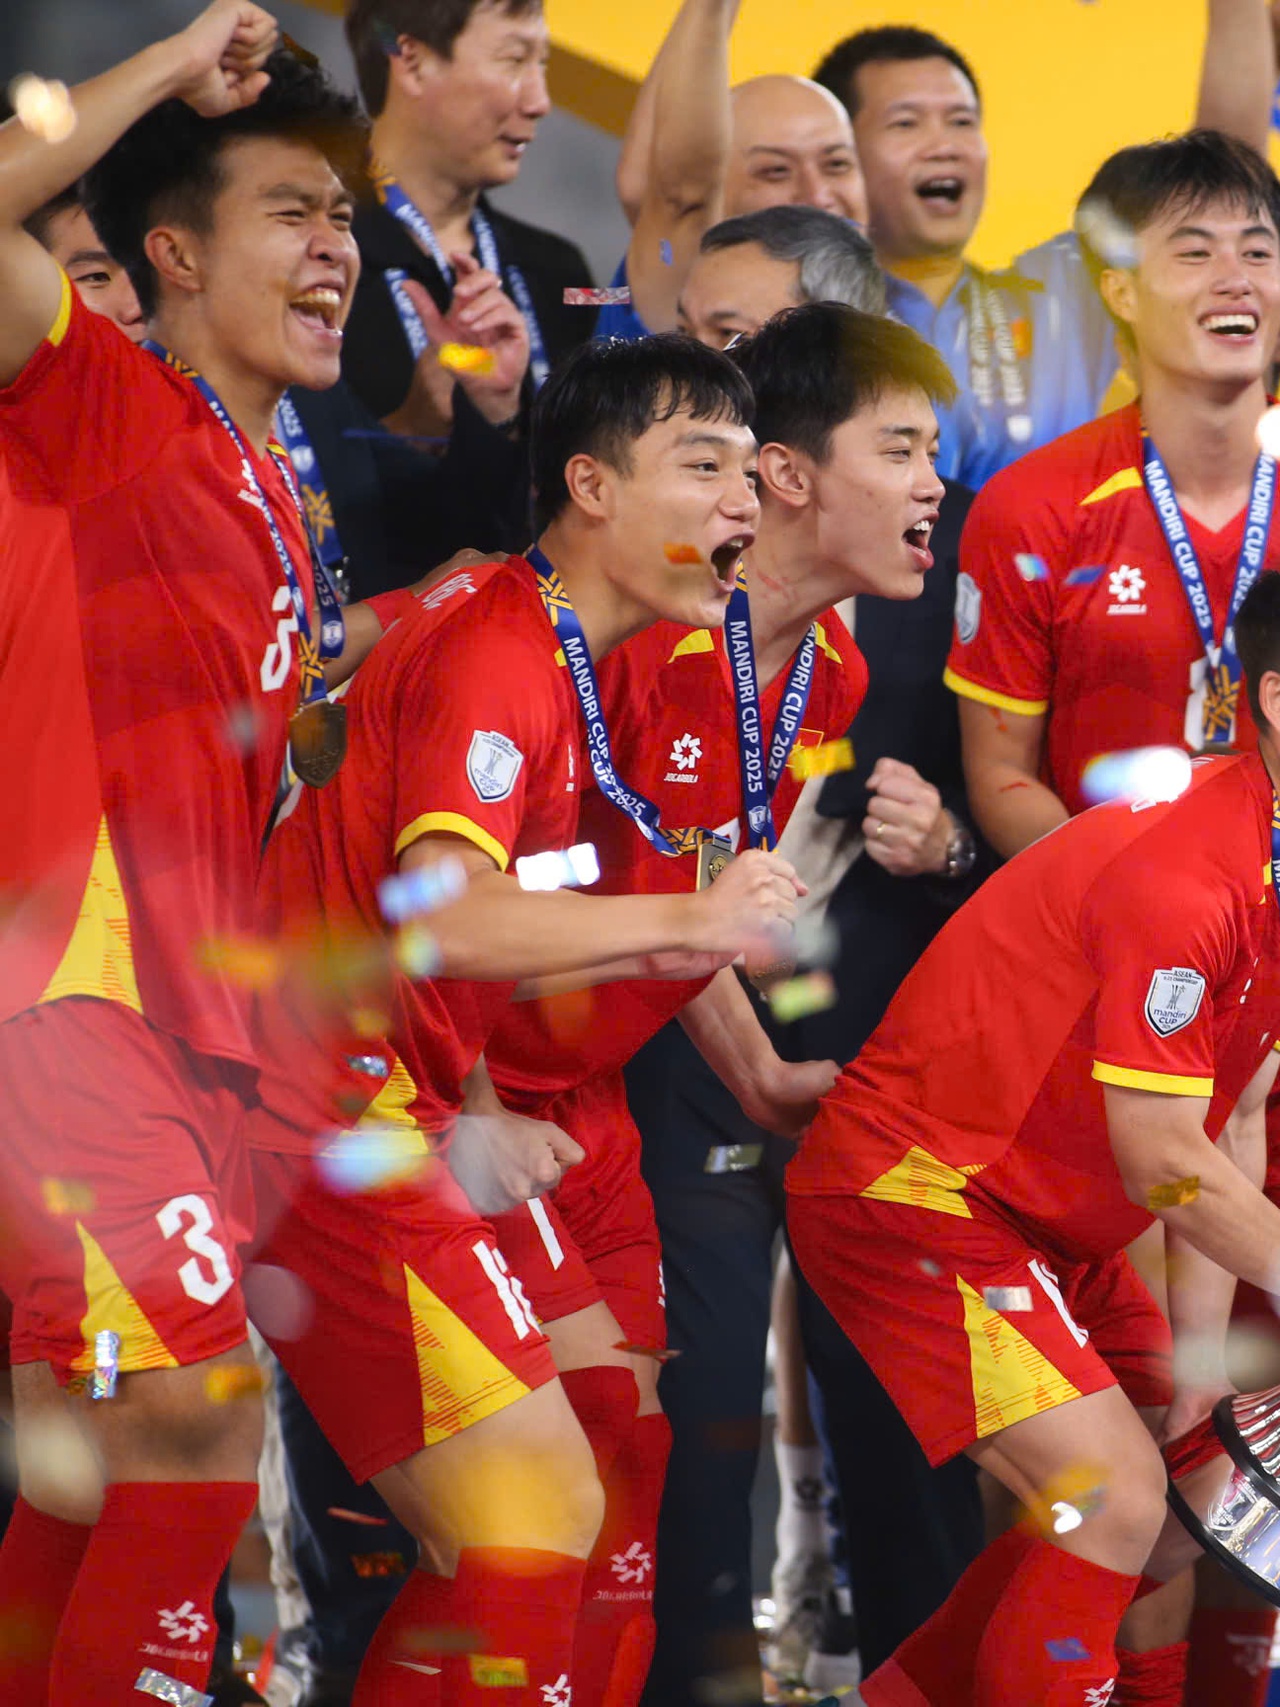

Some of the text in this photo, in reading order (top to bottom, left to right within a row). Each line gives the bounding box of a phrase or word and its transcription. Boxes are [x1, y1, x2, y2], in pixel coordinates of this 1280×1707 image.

[1142, 458, 1186, 541] MANDIRI
[1172, 539, 1201, 582] CUP
[1241, 524, 1264, 565] CUP
[1186, 580, 1213, 629] 2025
[563, 636, 599, 720] MANDIRI
[589, 721, 609, 759] CUP
[729, 619, 762, 792] MANDIRI CUP 2025
[766, 626, 815, 780] ANDIRI CUP 2025
[590, 749, 613, 785] CUP
[1173, 970, 1193, 979] ASEAN
[1153, 1008, 1187, 1019] mandiri
[1158, 1017, 1178, 1025] CUP
[155, 1194, 234, 1305] 3
